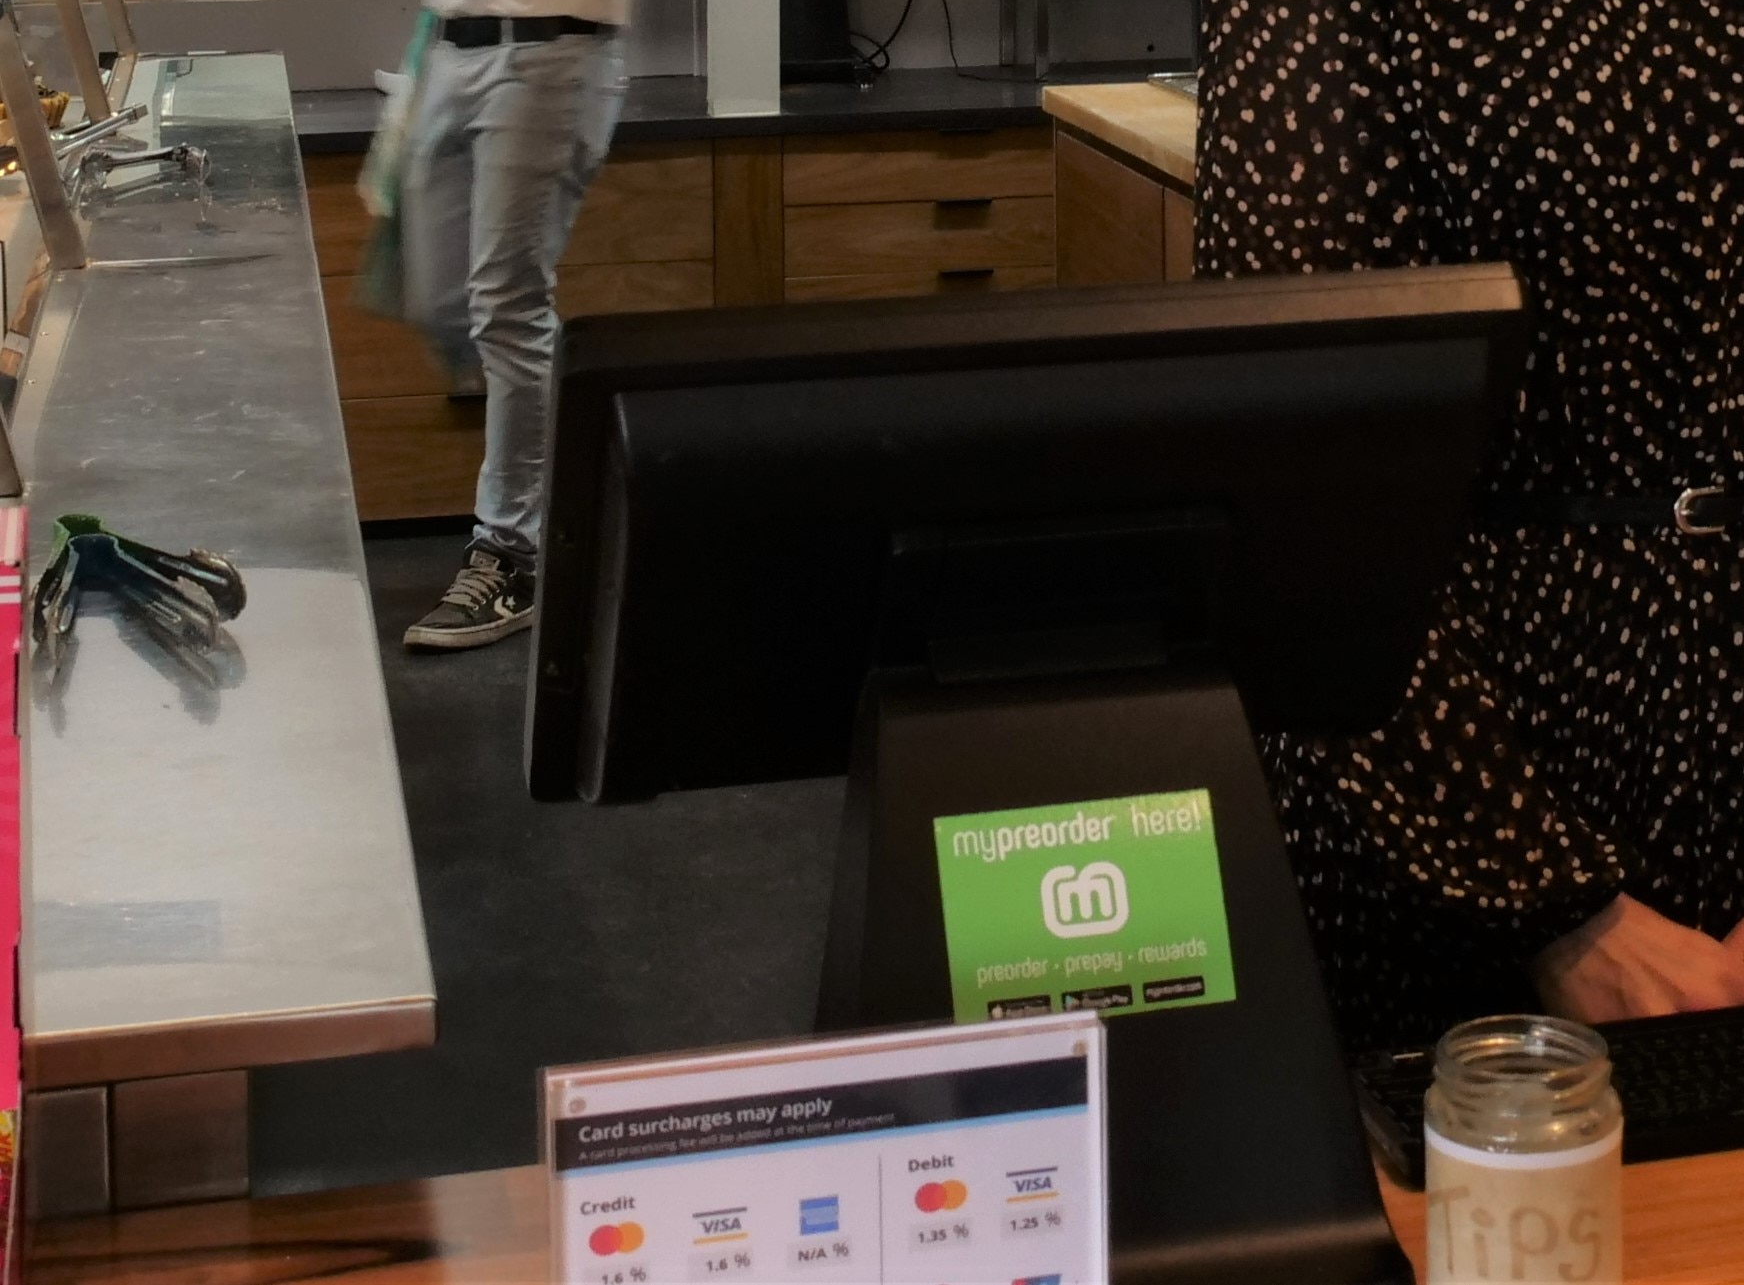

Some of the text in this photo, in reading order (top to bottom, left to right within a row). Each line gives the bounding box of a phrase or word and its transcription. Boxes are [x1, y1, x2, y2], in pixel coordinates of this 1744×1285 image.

[953, 800, 1201, 864] mypreorder here!
[975, 937, 1208, 990] preorder prepay rewards
[578, 1096, 833, 1143] Card surcharges may apply
[907, 1154, 955, 1173] Debit
[1012, 1176, 1053, 1194] VISA
[579, 1196, 636, 1216] Credit
[702, 1217, 742, 1234] VISA
[1010, 1211, 1062, 1232] 1.25 %
[917, 1222, 970, 1244] 1.35 %
[705, 1251, 751, 1273] 1.6 %
[797, 1241, 850, 1263] N/A %
[602, 1265, 647, 1285] 1.6 %
